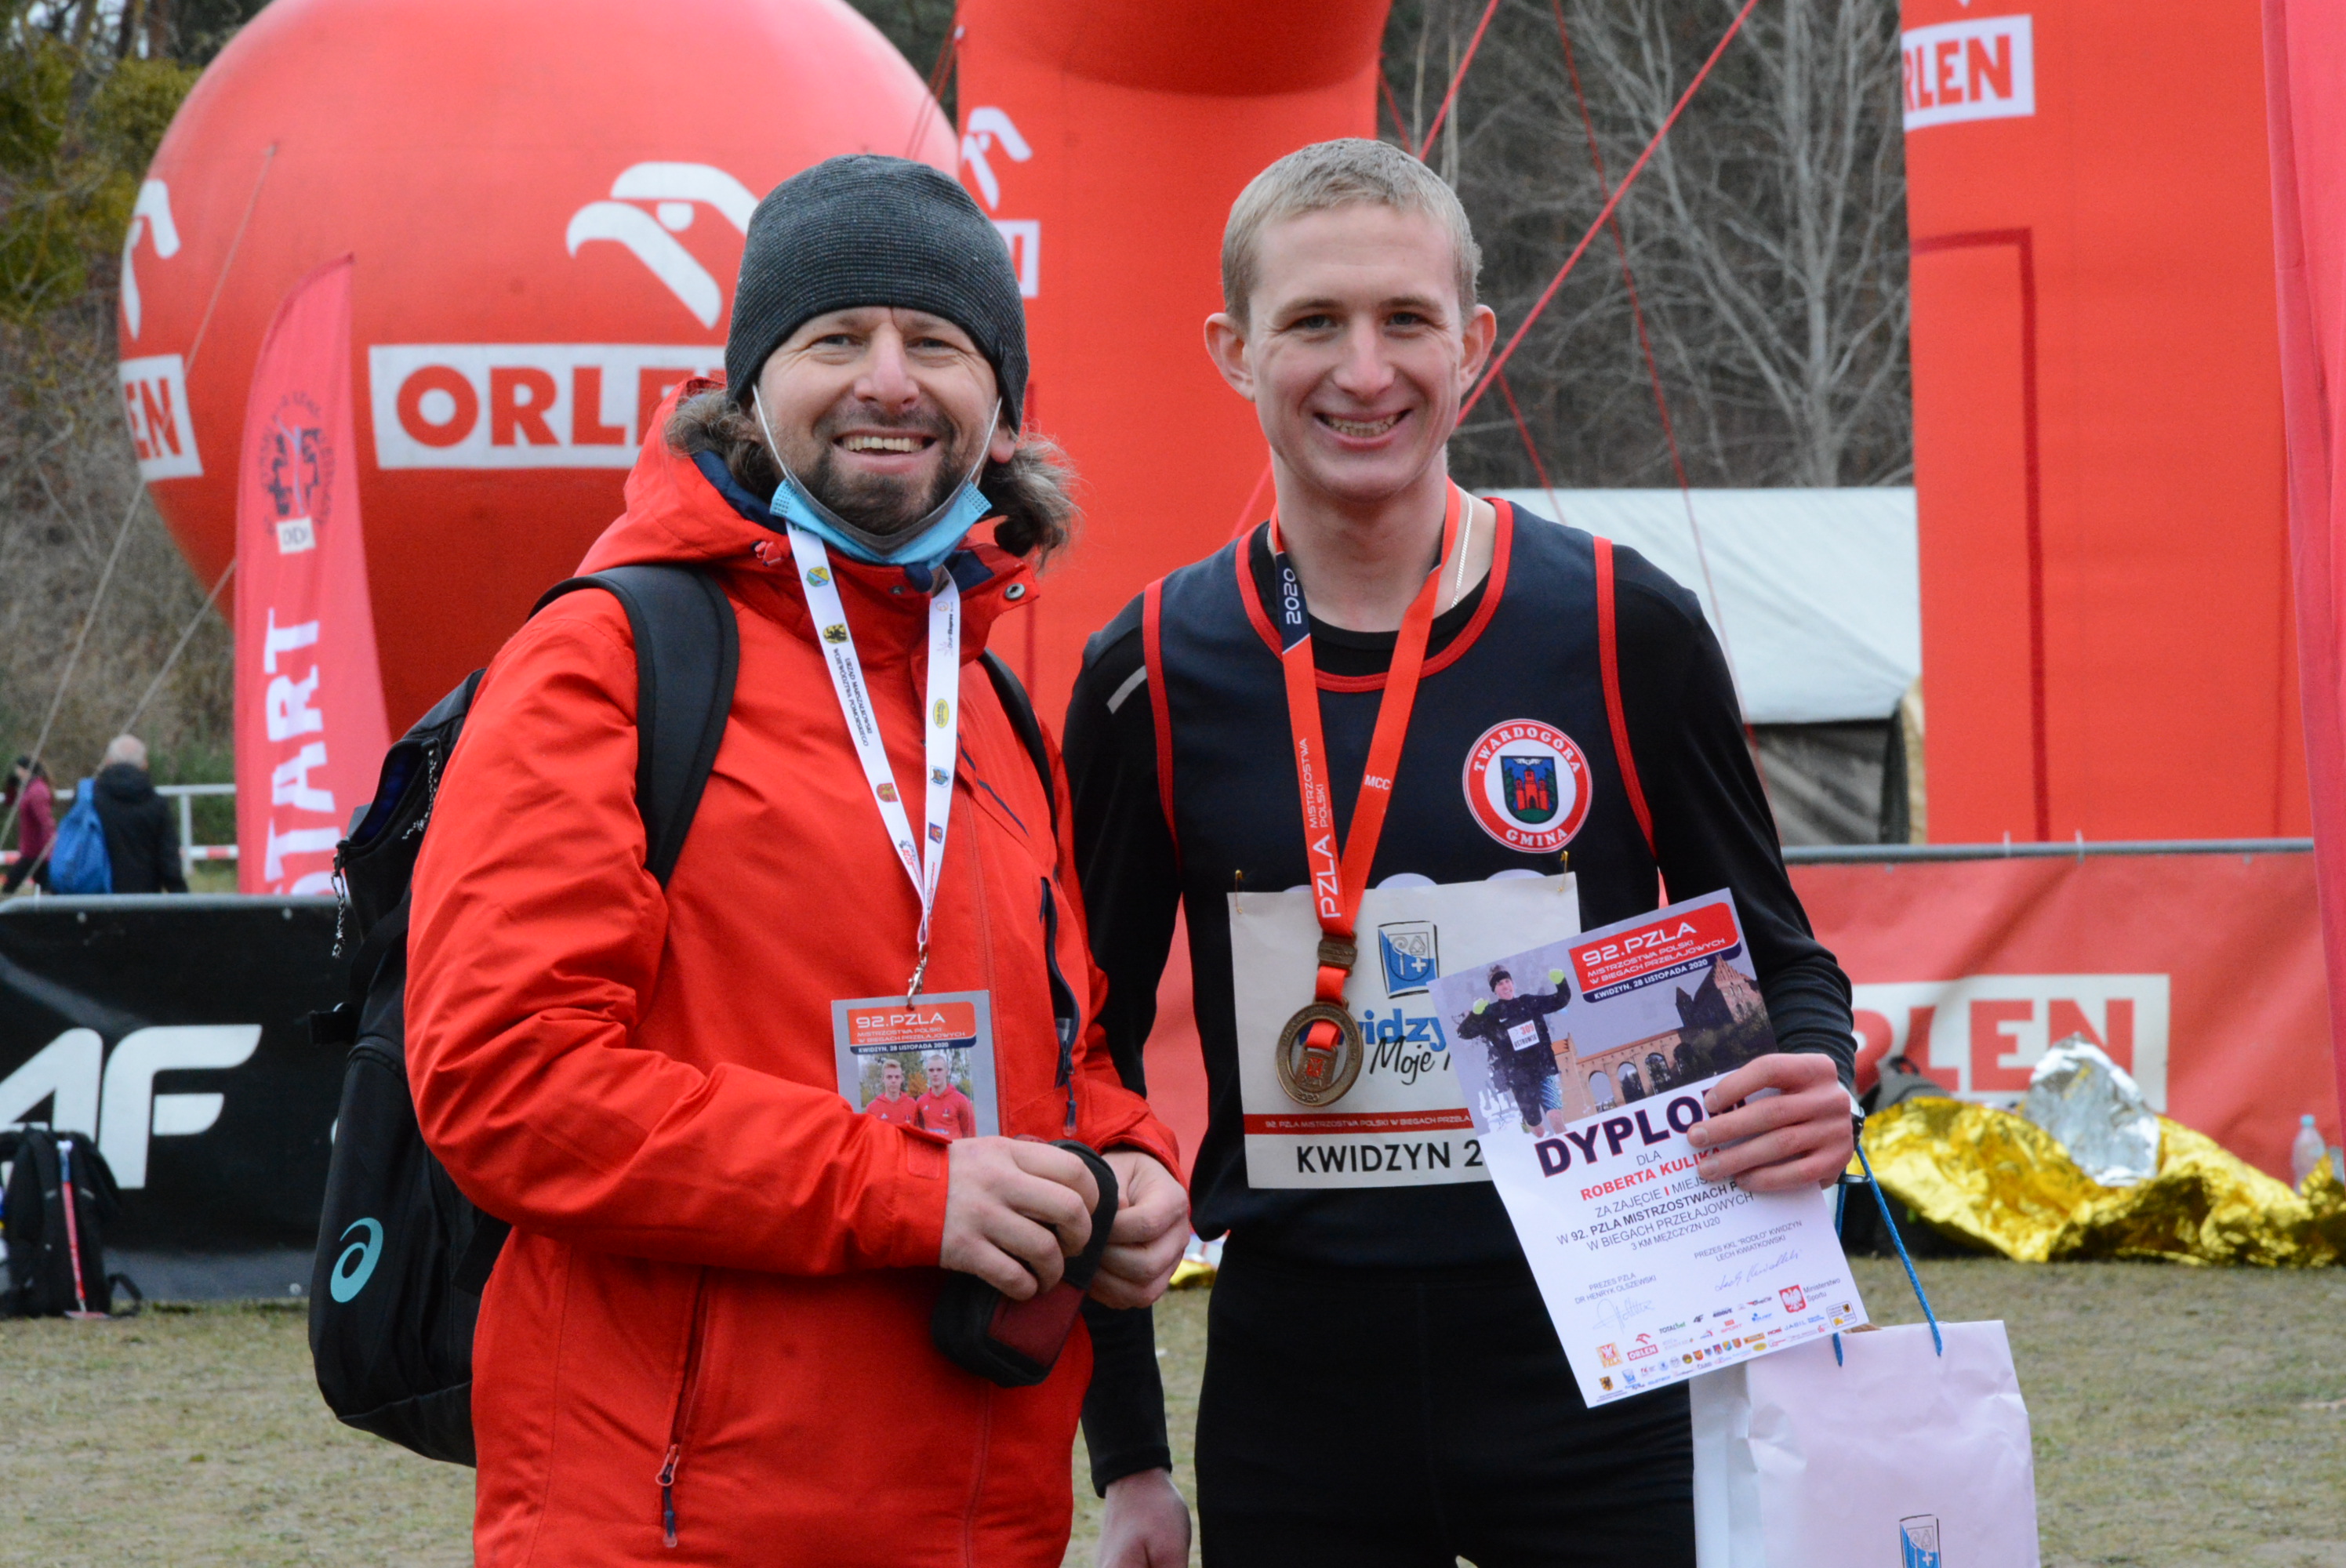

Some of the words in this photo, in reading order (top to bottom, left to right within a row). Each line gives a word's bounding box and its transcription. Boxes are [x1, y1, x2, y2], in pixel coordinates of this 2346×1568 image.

[1903, 33, 2013, 112] RLEN
[396, 364, 726, 448] ORLE
[1283, 568, 1302, 625] 2020
[1474, 727, 1582, 772] TWARDOGÓRA
[1298, 738, 1318, 829] MISTRZOSTWA
[1364, 774, 1391, 790] MCC
[1316, 783, 1328, 828] POLSKI
[1505, 828, 1567, 847] GMINA
[1312, 834, 1342, 919] PZLA
[1587, 952, 1658, 978] MISTRZOSTWA
[1658, 939, 1694, 955] POLSKI
[1600, 965, 1643, 982] BIEGACH
[1593, 983, 1632, 1000] KWIDZYN,
[1633, 978, 1643, 988] 28
[1645, 966, 1687, 985] LISTOPADA
[1688, 959, 1708, 971] 2020
[1520, 1023, 1534, 1036] 309
[1369, 1035, 1436, 1085] Moje
[1400, 1116, 1436, 1125] BIEGACH
[1297, 1142, 1451, 1173] KWIDZYN
[1636, 1150, 1662, 1166] DLA
[1580, 1168, 1657, 1201] ROBERTA
[1595, 1205, 1613, 1218] ZA
[1612, 1189, 1662, 1214] ZAJĘCIE
[1664, 1186, 1670, 1196] I
[1672, 1176, 1709, 1194] MIEJS
[1556, 1234, 1570, 1245] W
[1571, 1229, 1589, 1242] 92.
[1589, 1219, 1622, 1236] PZLA
[1622, 1184, 1727, 1226] MISTRZOSTWACH
[1587, 1240, 1600, 1251] W
[1602, 1225, 1654, 1247] BIEGACH
[1656, 1192, 1754, 1230] PRZEŁAJOWYCH
[1631, 1241, 1638, 1250] 3
[1638, 1236, 1654, 1248] KM
[1703, 1216, 1721, 1229] U20
[1694, 1247, 1723, 1260] PREZES
[1723, 1243, 1737, 1253] KKL
[1768, 1220, 1802, 1236] KWIDZYN
[1716, 1250, 1735, 1262] LECH
[1735, 1235, 1786, 1256] KWIATKOWSKI
[1574, 1296, 1586, 1305] DR
[1586, 1288, 1616, 1301] HENRYK
[1617, 1275, 1657, 1294] OLSZEWSKI
[1589, 1278, 1617, 1291] PREZES
[1618, 1272, 1636, 1284] PZLA
[1803, 1278, 1841, 1294] Ministerstwo
[1807, 1291, 1827, 1302] Sportu
[1629, 1345, 1657, 1360] ORLEN
